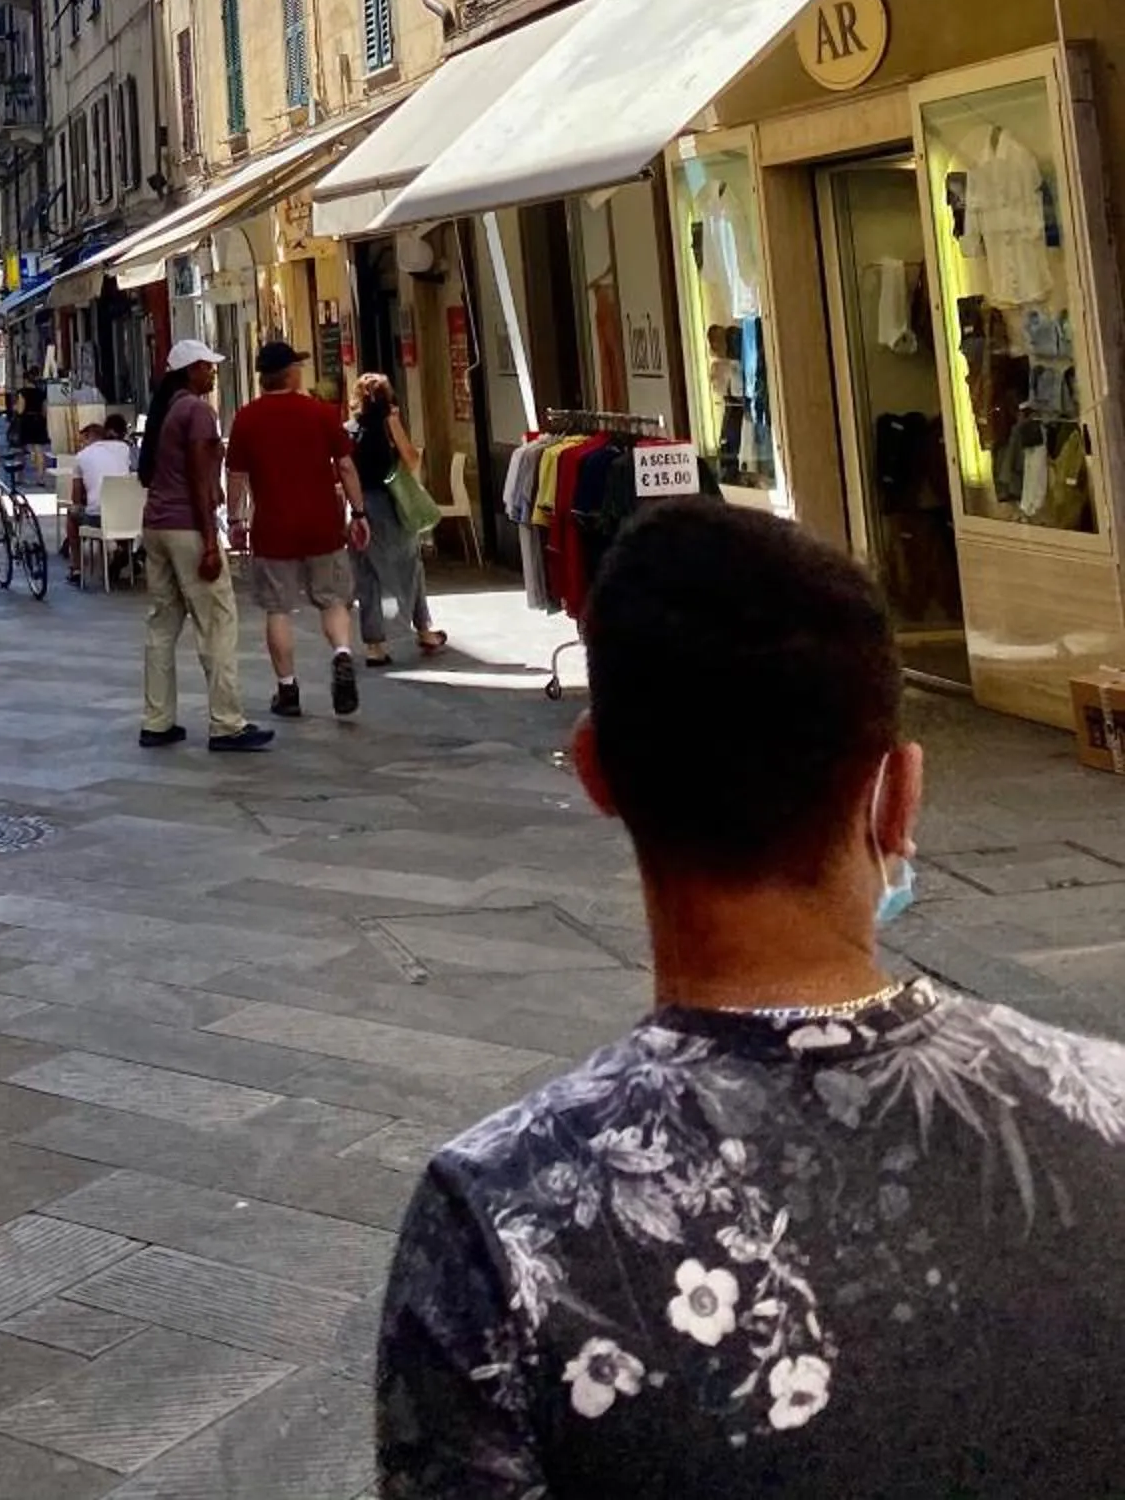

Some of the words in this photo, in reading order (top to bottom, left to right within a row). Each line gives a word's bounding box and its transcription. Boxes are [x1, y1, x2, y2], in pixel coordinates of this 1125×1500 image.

[816, 1, 868, 65] AR
[640, 455, 648, 467] A
[650, 453, 691, 466] SCELTA
[642, 473, 650, 487] €
[655, 471, 692, 486] 15.00
